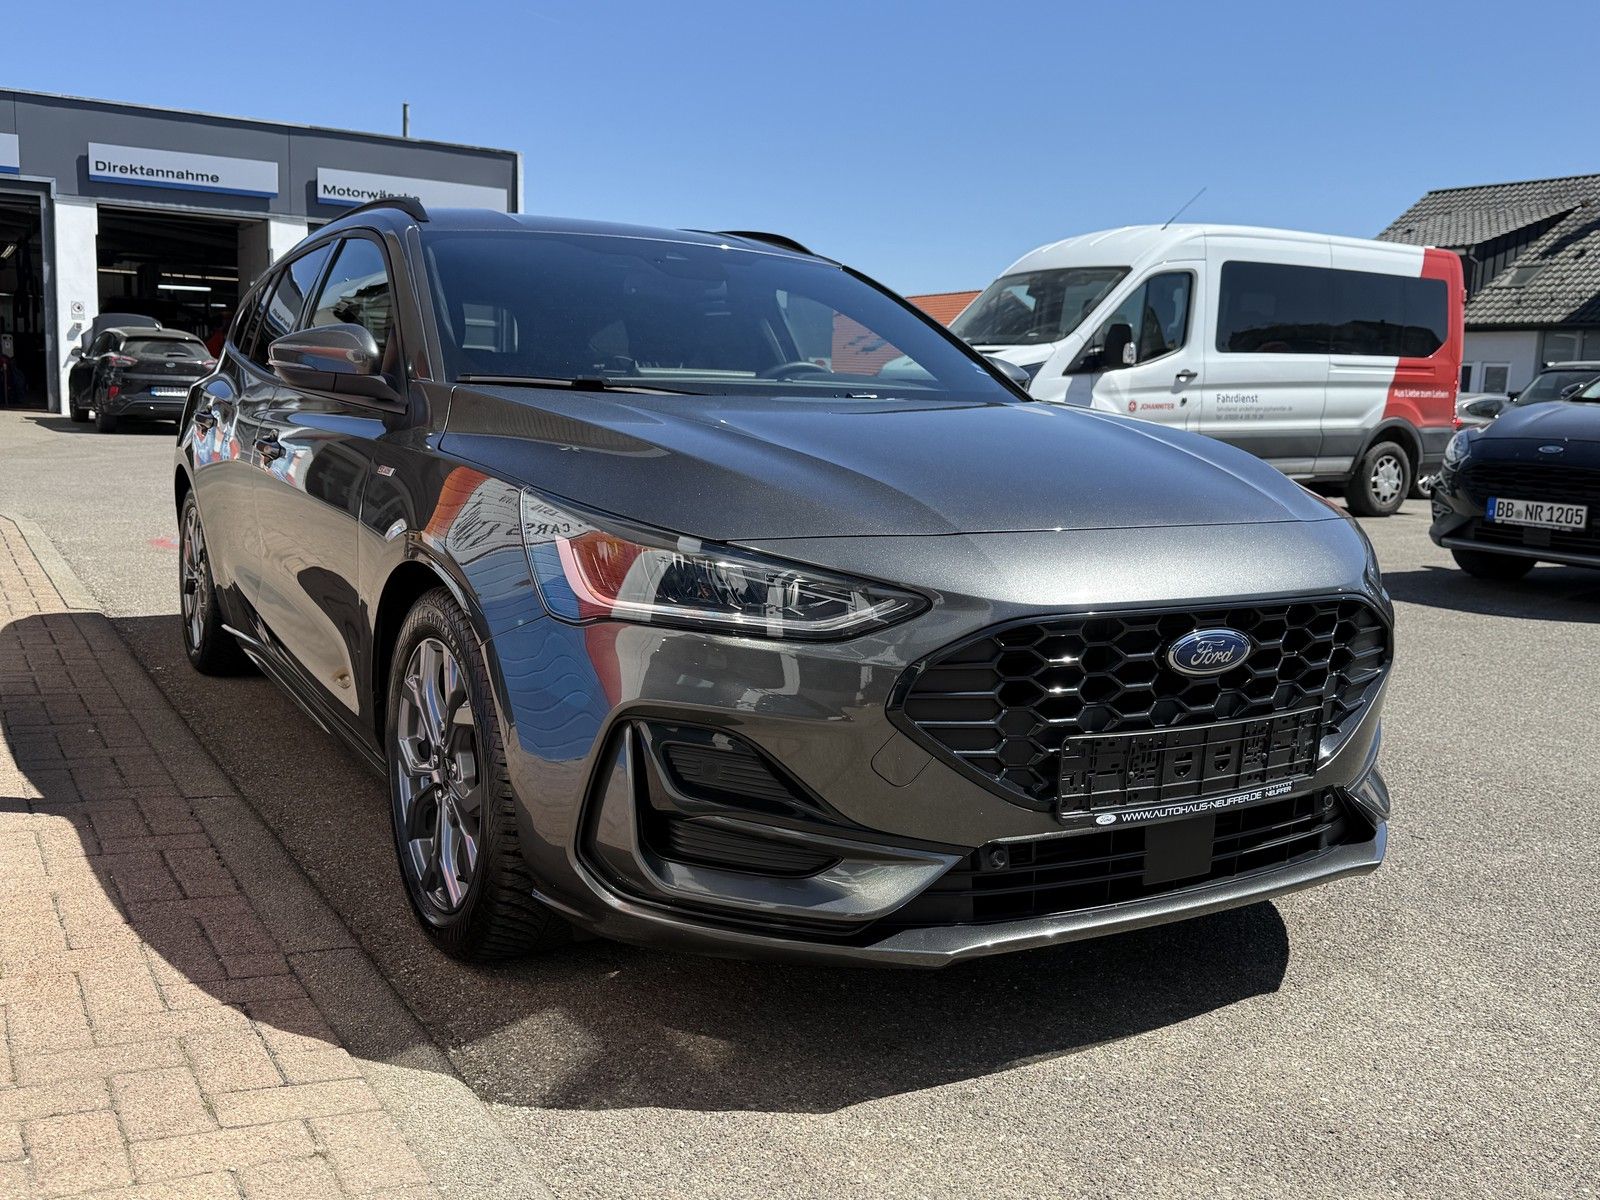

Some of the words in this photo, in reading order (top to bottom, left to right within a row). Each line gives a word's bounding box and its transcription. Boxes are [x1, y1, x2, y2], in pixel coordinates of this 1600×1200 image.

[95, 160, 220, 184] Direktannahme
[1216, 393, 1258, 404] Fahrdienst
[1496, 501, 1515, 518] BB
[1524, 503, 1544, 521] NR
[1546, 505, 1584, 526] 1205
[1190, 639, 1236, 666] Ford
[1265, 785, 1293, 798] NEUFFER
[1121, 791, 1263, 823] WWW.AUTOHAUS-NEUFFER.DE
